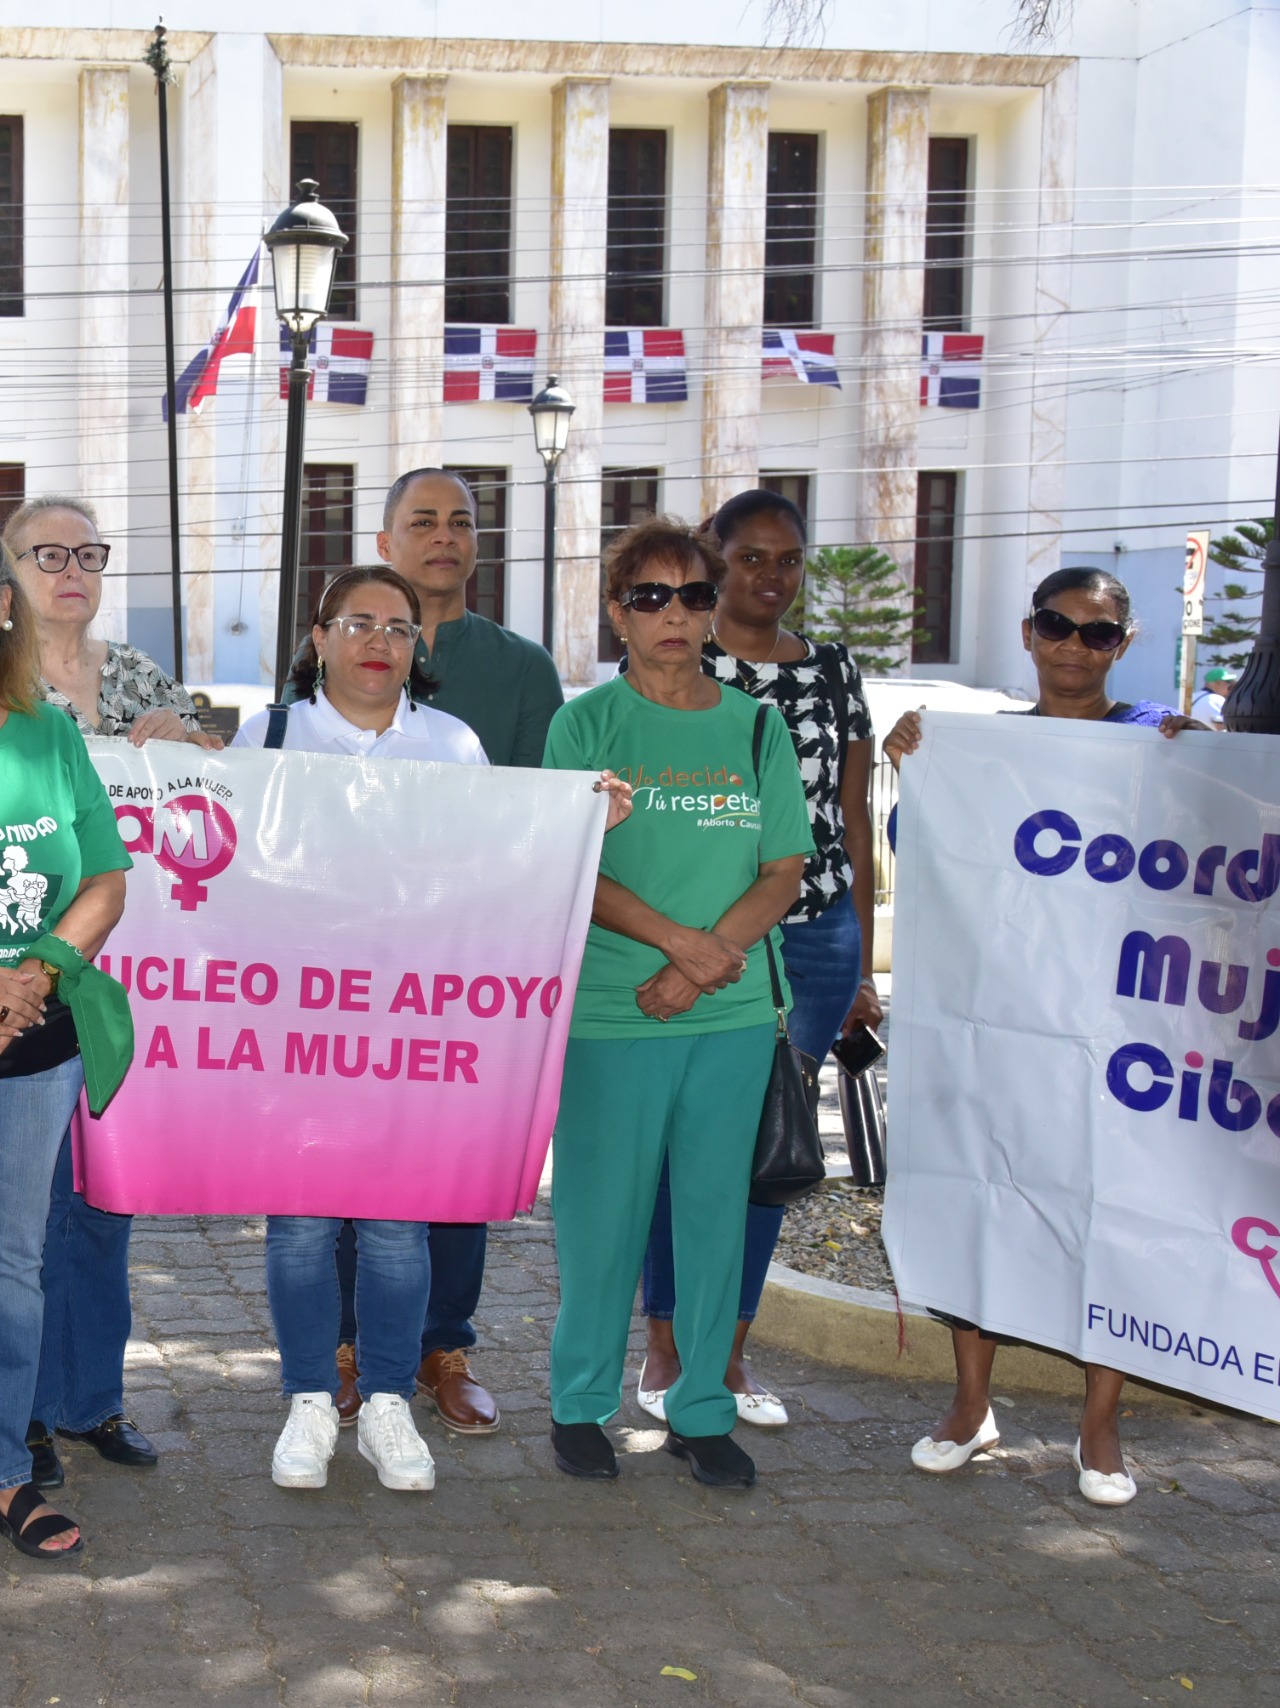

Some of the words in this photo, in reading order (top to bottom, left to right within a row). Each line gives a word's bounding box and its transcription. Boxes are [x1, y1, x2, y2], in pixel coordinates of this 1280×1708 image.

[109, 784, 124, 798] DE
[168, 782, 176, 793] A
[177, 777, 193, 789] LA
[1014, 809, 1280, 902] Coord
[90, 954, 278, 1006] UCLEO
[299, 966, 373, 1012] DE
[388, 972, 563, 1019] APOYO
[144, 1025, 179, 1069] A
[197, 1027, 265, 1072] LA
[284, 1031, 479, 1084] MUJER
[1106, 1042, 1280, 1140] Cib
[1088, 1303, 1244, 1377] FUNDADA
[1254, 1351, 1280, 1387] E
